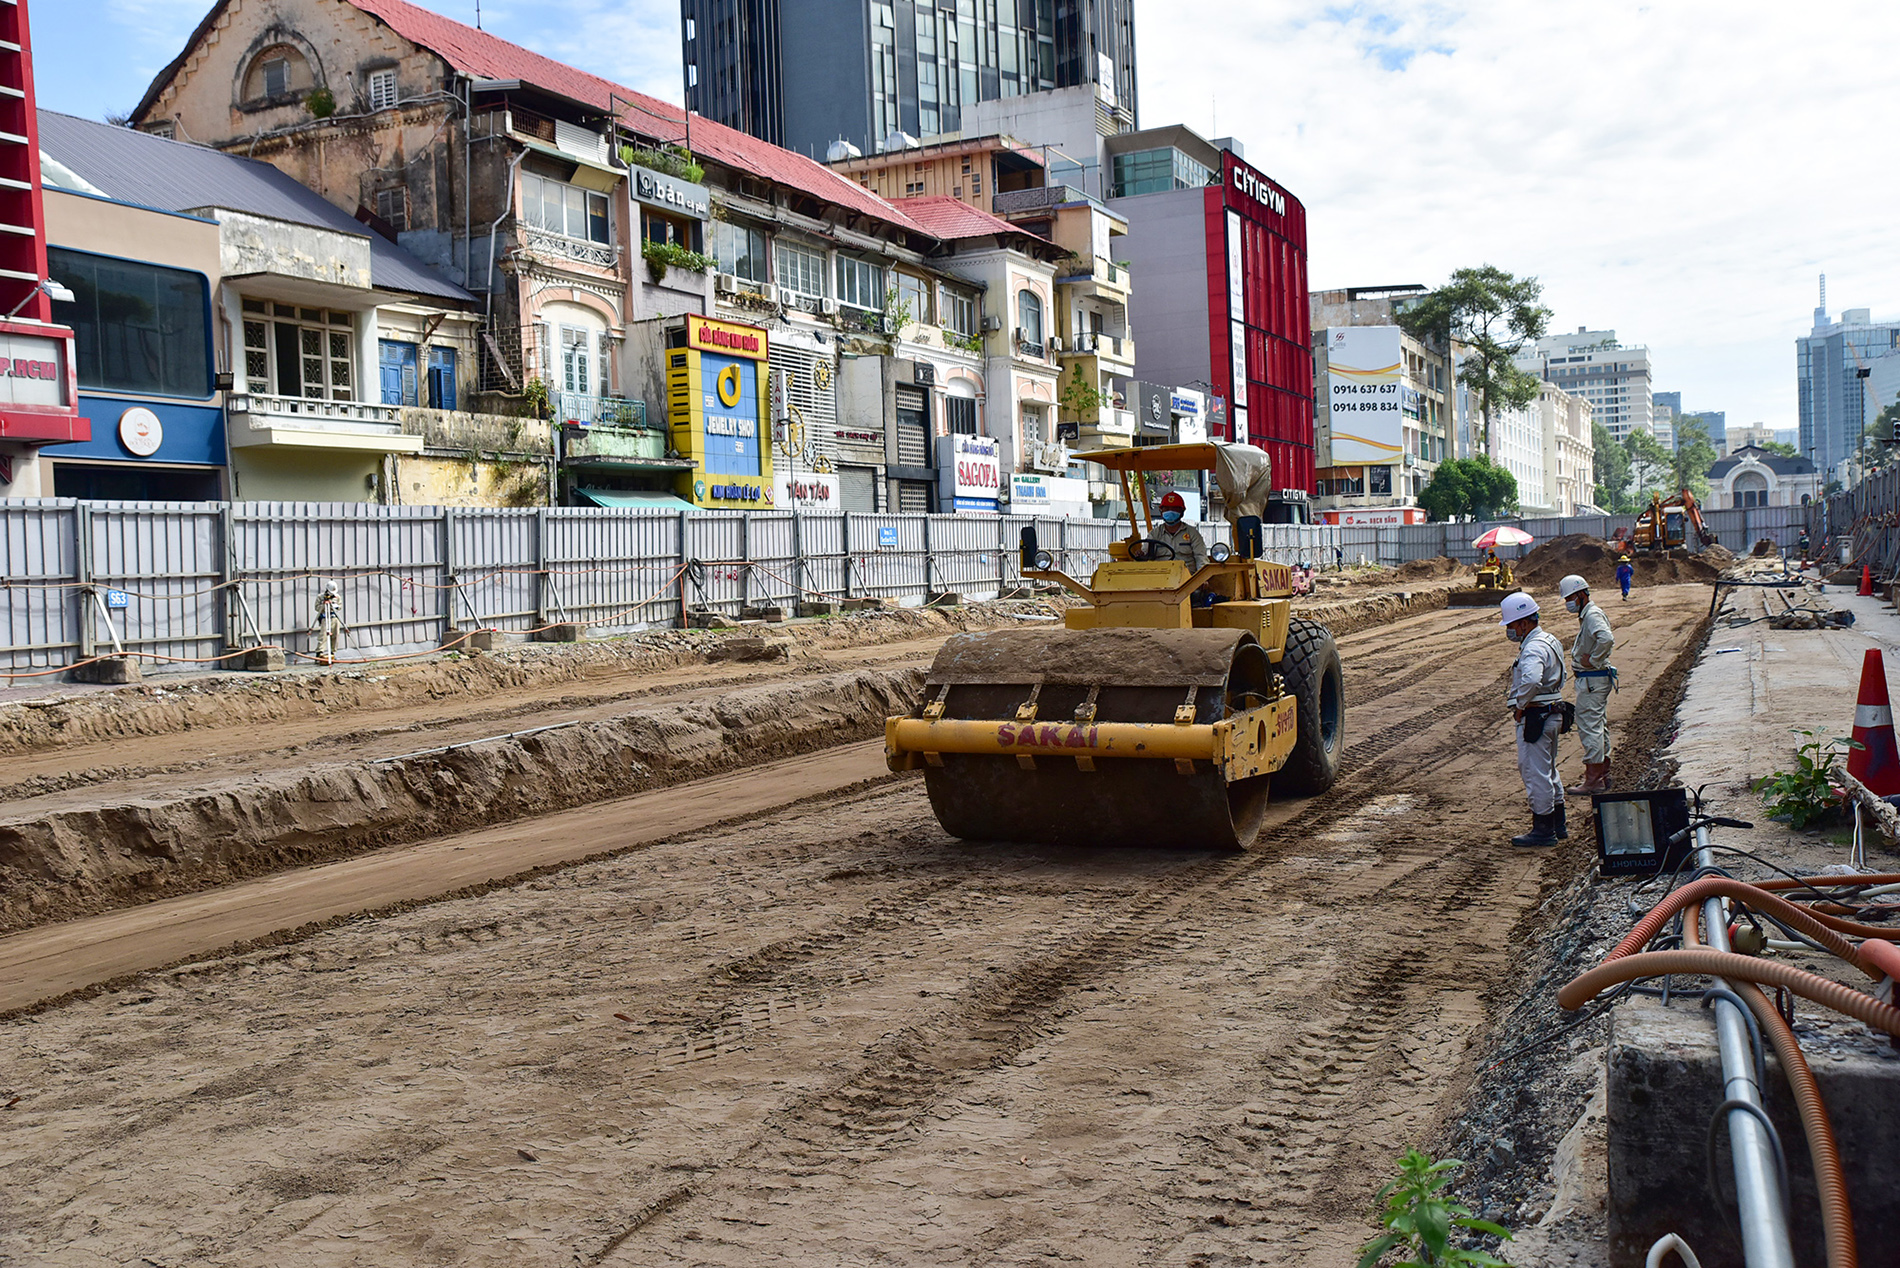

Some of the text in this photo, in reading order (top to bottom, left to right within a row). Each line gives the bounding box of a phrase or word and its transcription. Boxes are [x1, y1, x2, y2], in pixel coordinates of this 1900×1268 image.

[1233, 165, 1286, 217] CITIGYM
[730, 333, 742, 349] KIM
[0, 357, 56, 381] P.HCM
[1333, 384, 1397, 394] 0914 637 637
[1333, 402, 1398, 412] 0914 898 834
[707, 416, 755, 437] JEWELRY SHOP
[958, 461, 998, 488] SAGOFA
[712, 485, 724, 499] KIM
[1282, 488, 1307, 500] CITIGYM
[1262, 568, 1289, 592] SAKAI
[997, 724, 1098, 748] SAKAI
[1611, 858, 1657, 868] CITYLIGHT
